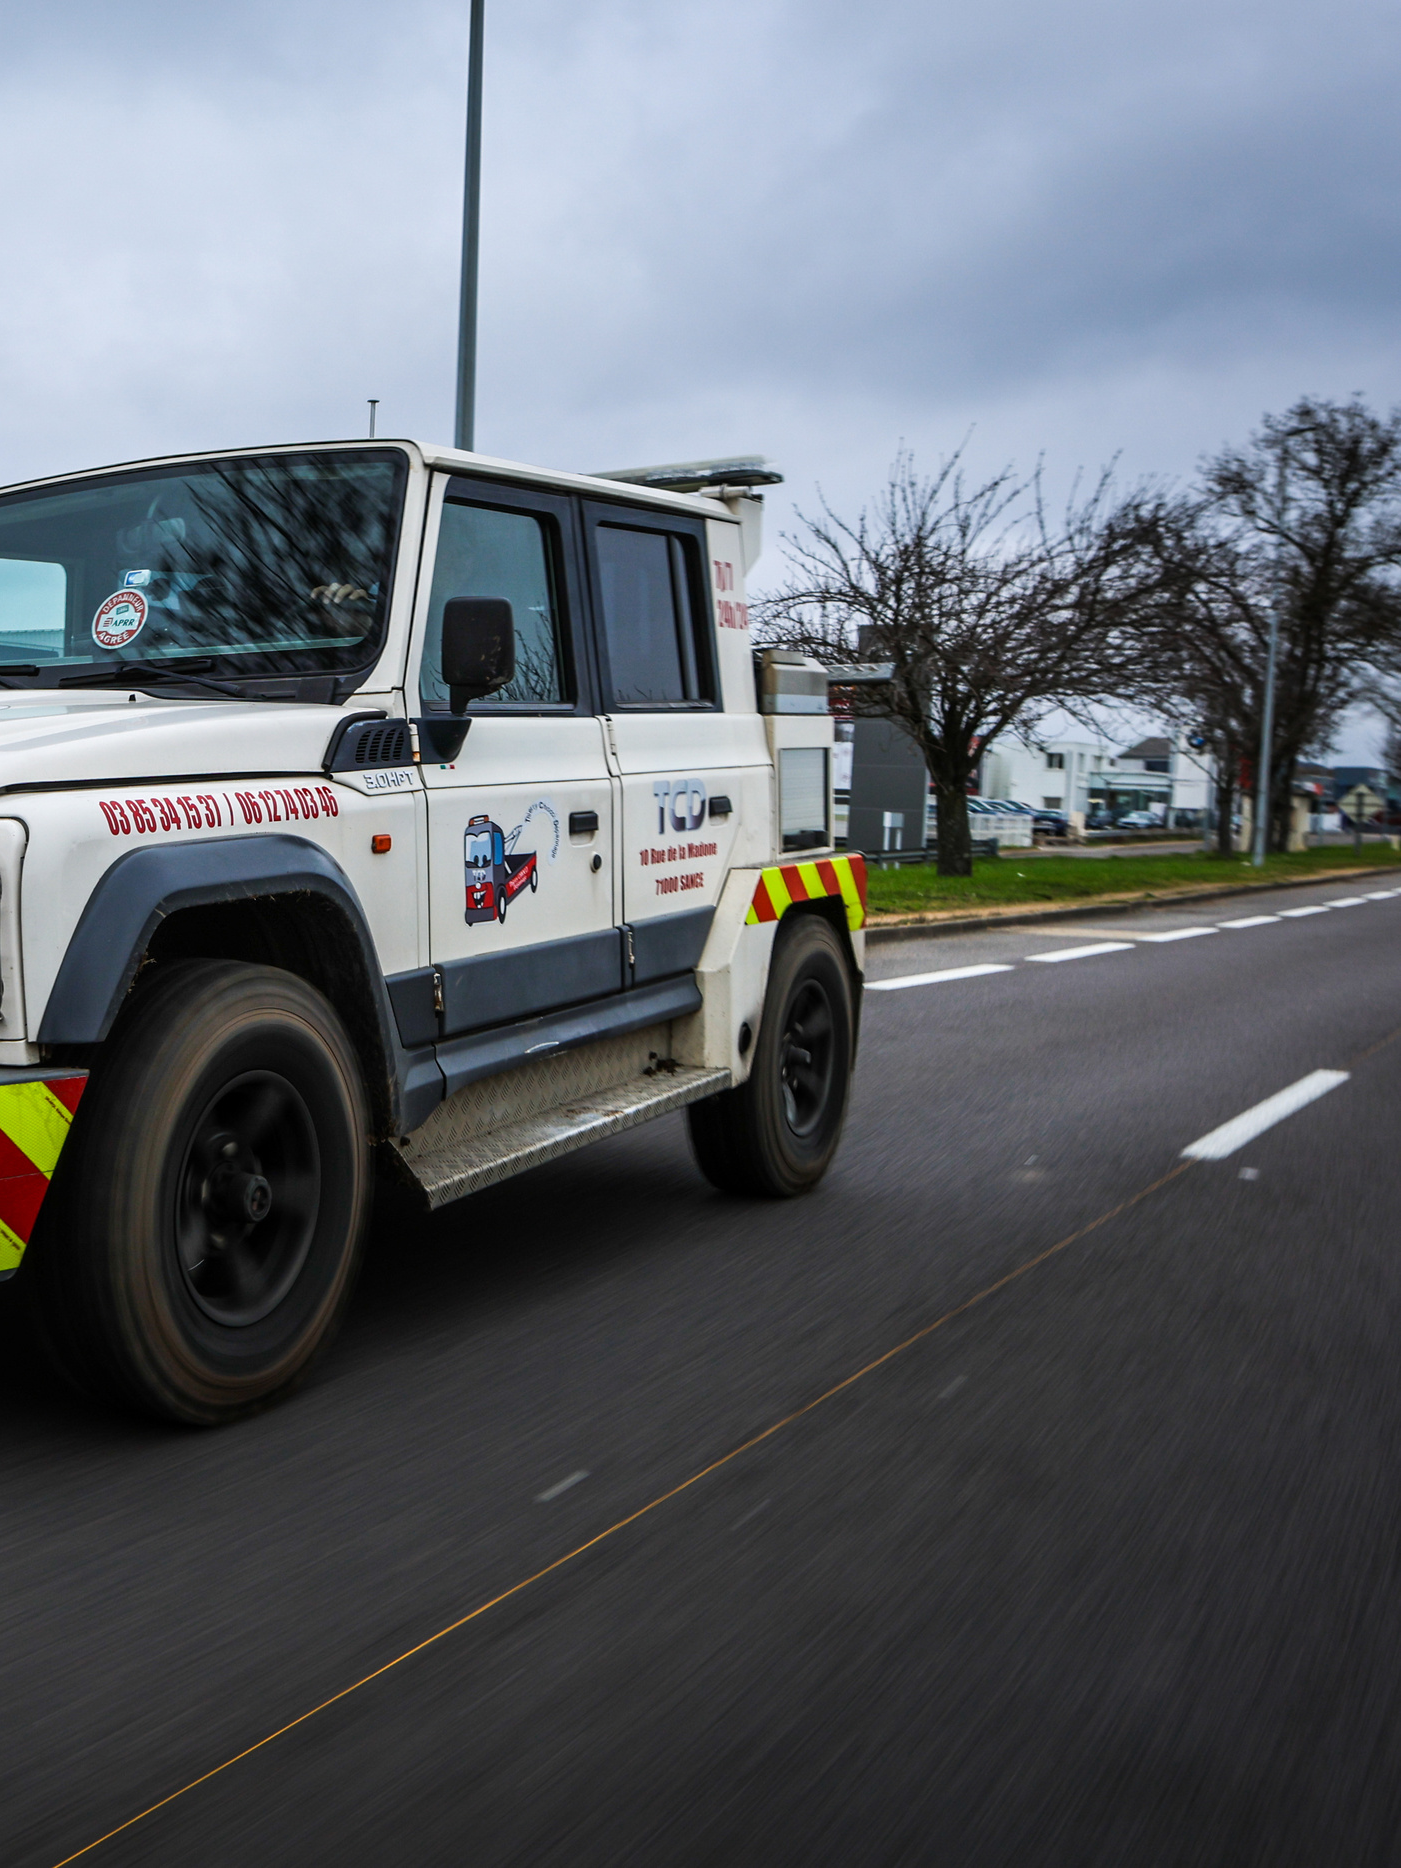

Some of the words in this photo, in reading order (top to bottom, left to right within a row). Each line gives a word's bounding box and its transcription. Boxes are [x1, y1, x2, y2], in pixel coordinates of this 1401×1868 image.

[112, 618, 135, 627] APRR
[99, 801, 131, 835] 03
[126, 799, 157, 834] 85
[151, 797, 181, 831] 34
[176, 796, 202, 829] 15
[196, 794, 222, 828] 37
[234, 791, 262, 825] 06
[258, 790, 282, 823] 12
[274, 789, 299, 821] 74
[293, 788, 319, 819] 03
[314, 786, 339, 817] 46
[653, 778, 706, 835] TCD
[639, 849, 649, 866] 10
[650, 847, 666, 864] Rue
[667, 845, 677, 862] de
[678, 844, 687, 860] la
[687, 841, 717, 859] Madone
[655, 876, 679, 895] 71000
